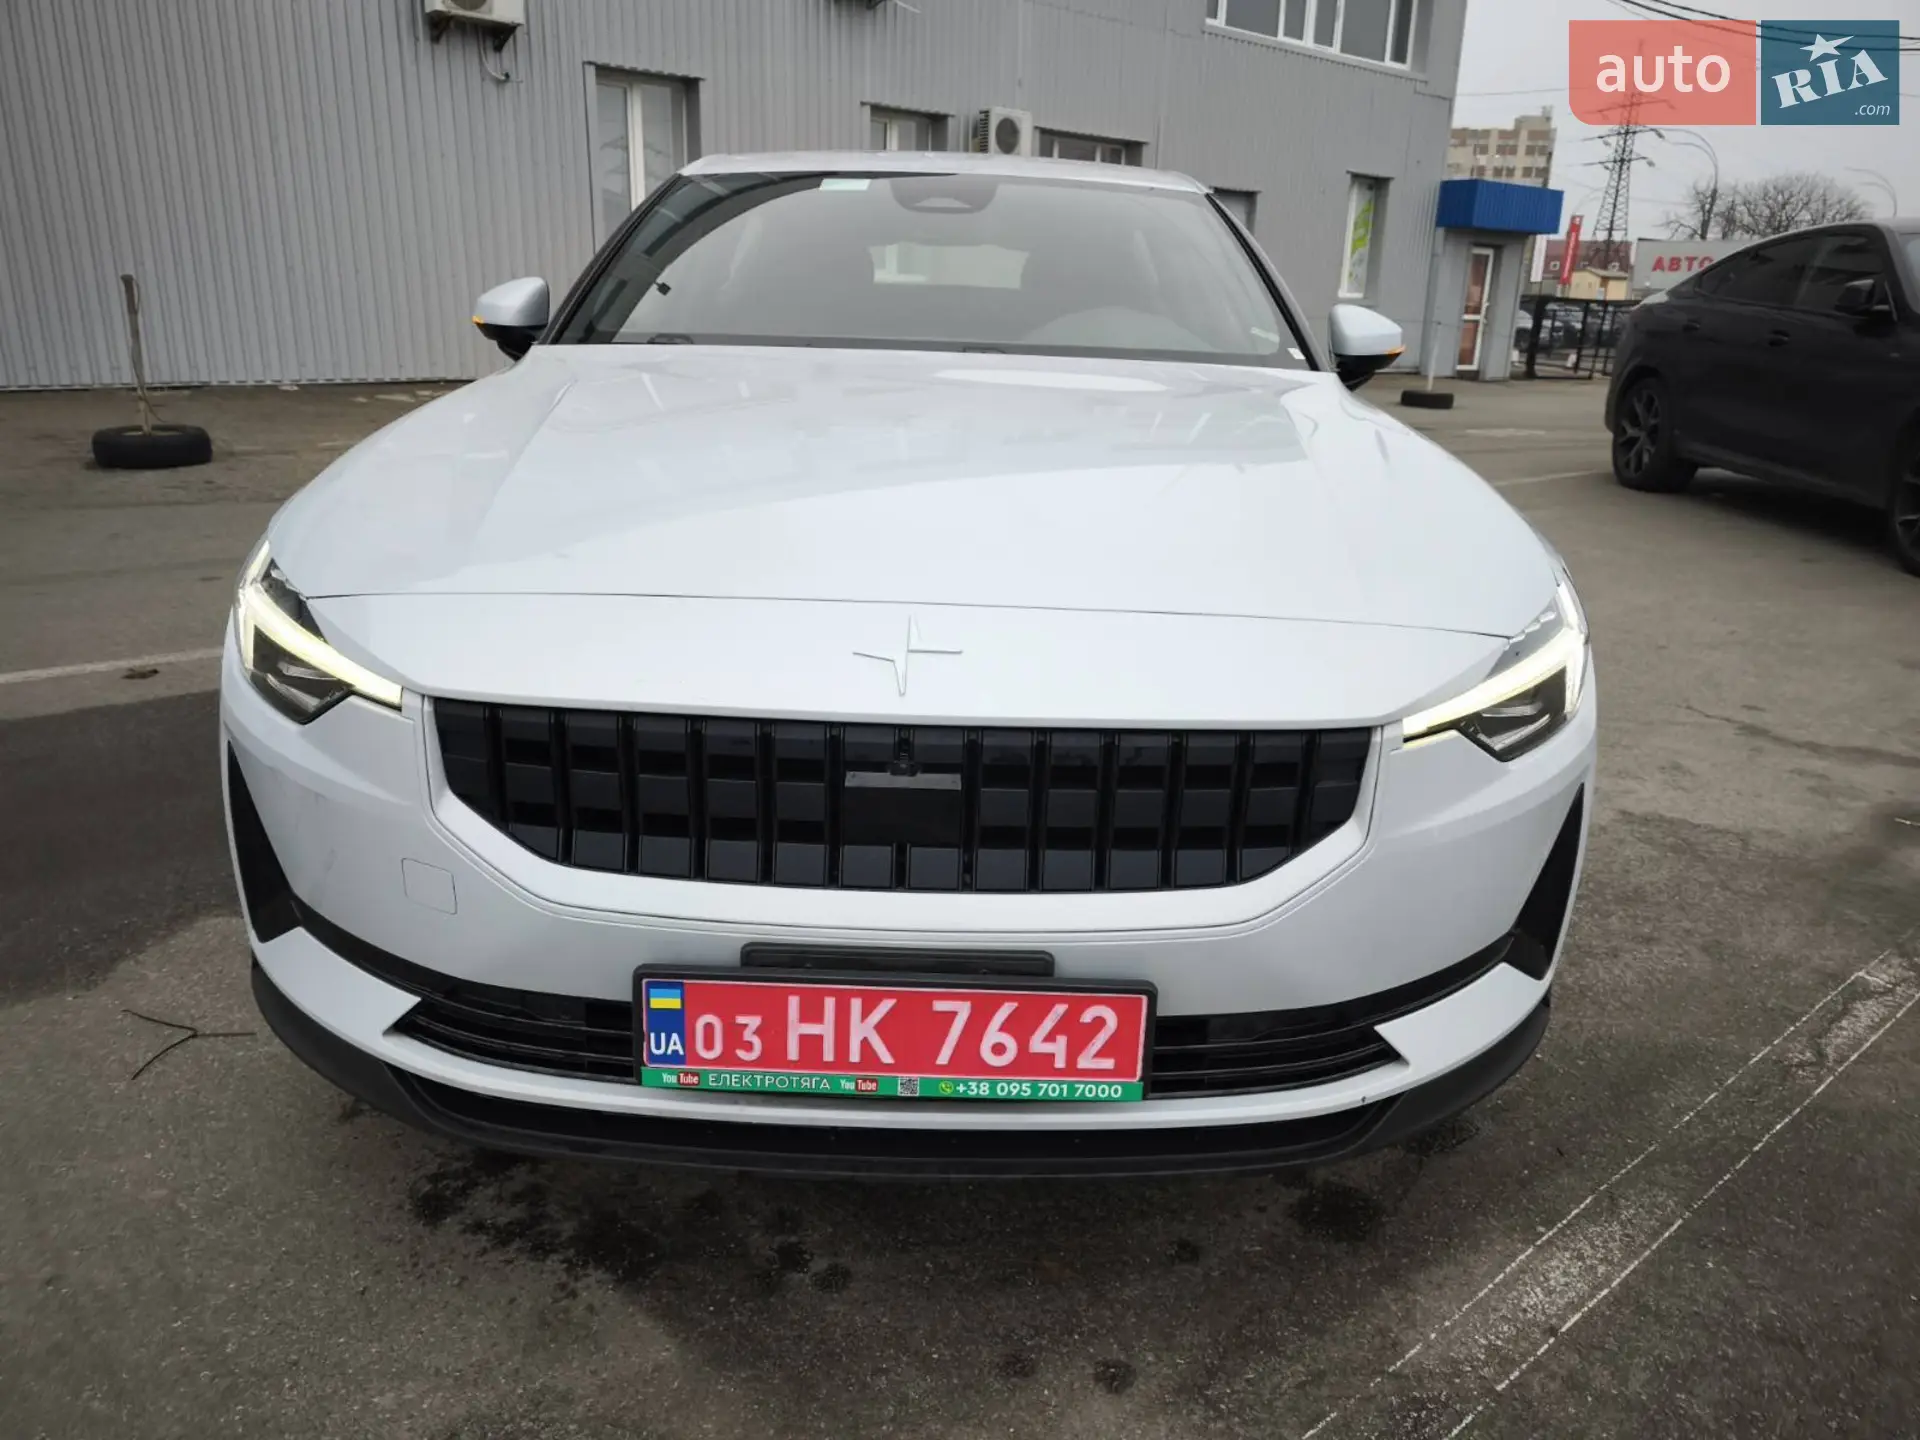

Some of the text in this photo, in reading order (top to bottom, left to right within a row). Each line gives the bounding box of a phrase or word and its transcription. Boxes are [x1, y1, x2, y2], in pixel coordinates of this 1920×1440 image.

[932, 1000, 1118, 1069] 7642
[650, 1032, 684, 1055] UA
[662, 1072, 699, 1085] YouTube
[709, 1073, 831, 1090] ЕЛЕКТРОТЯГА
[840, 1079, 877, 1092] YouTube
[956, 1081, 1122, 1099] +38 095 701 7000
